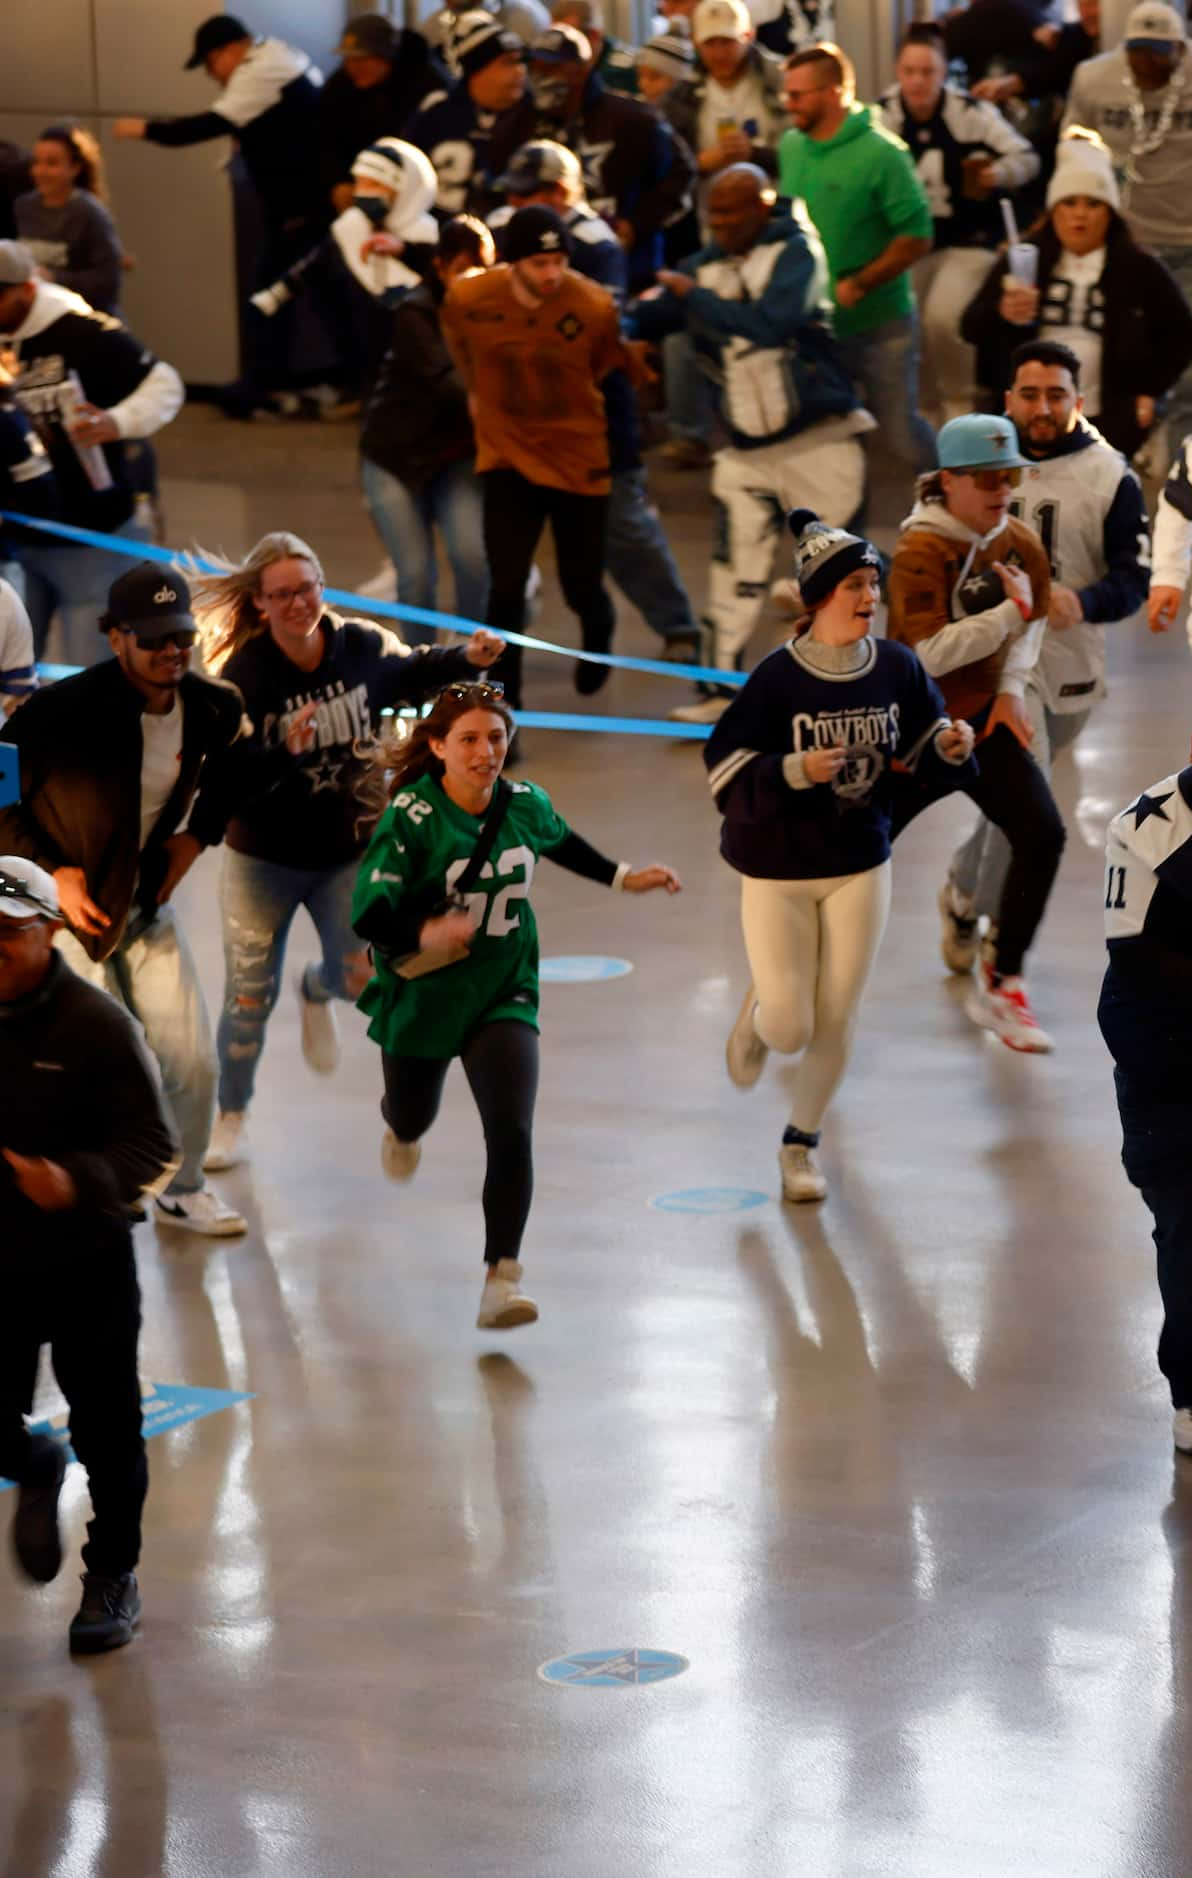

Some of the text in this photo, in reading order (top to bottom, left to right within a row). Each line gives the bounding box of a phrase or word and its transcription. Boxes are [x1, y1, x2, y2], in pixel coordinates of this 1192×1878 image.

[153, 584, 177, 604] alo
[792, 702, 901, 753] COWBOYS
[1105, 865, 1127, 910] 11
